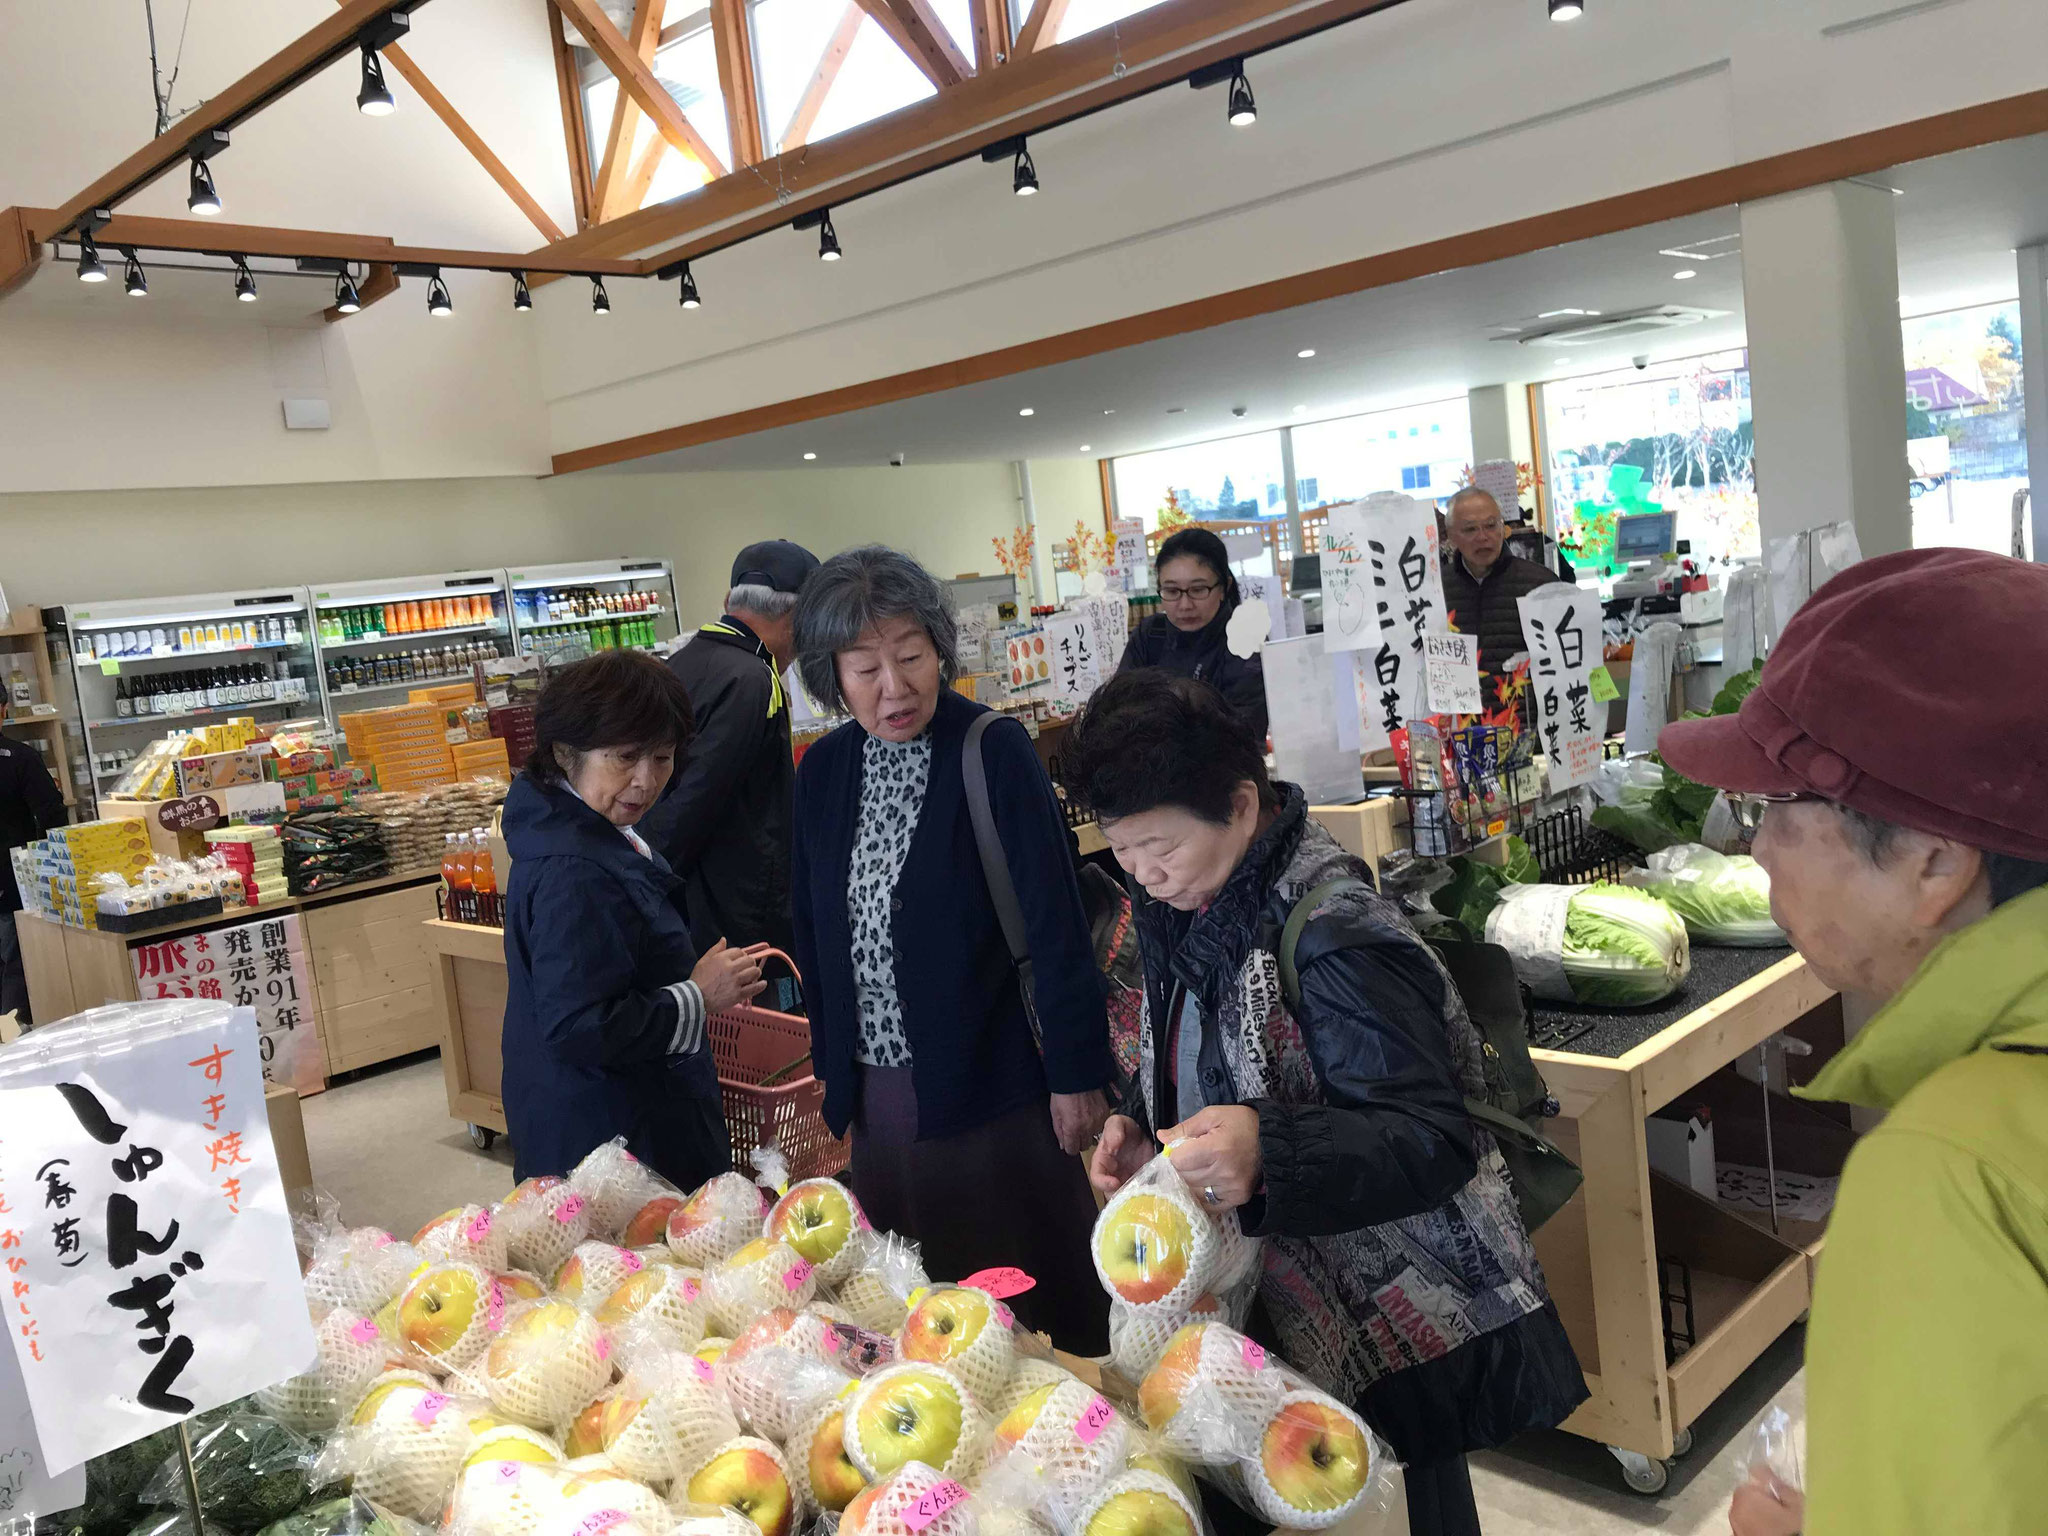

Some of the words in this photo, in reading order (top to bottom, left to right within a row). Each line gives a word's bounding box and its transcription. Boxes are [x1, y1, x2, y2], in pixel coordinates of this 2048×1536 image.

[1060, 637, 1079, 694] チップス
[1074, 623, 1092, 670] りんご
[1530, 619, 1562, 768] ミニ白菜
[1555, 605, 1591, 734] 白菜
[161, 801, 197, 821] 群馬の
[179, 805, 215, 826] お土産
[230, 805, 282, 820] 群馬のお土産
[260, 920, 301, 1031] 創業91年
[187, 1043, 251, 1214] すき焼き
[35, 1158, 89, 1267] (春菊)
[55, 1082, 204, 1415] しゅんぎく
